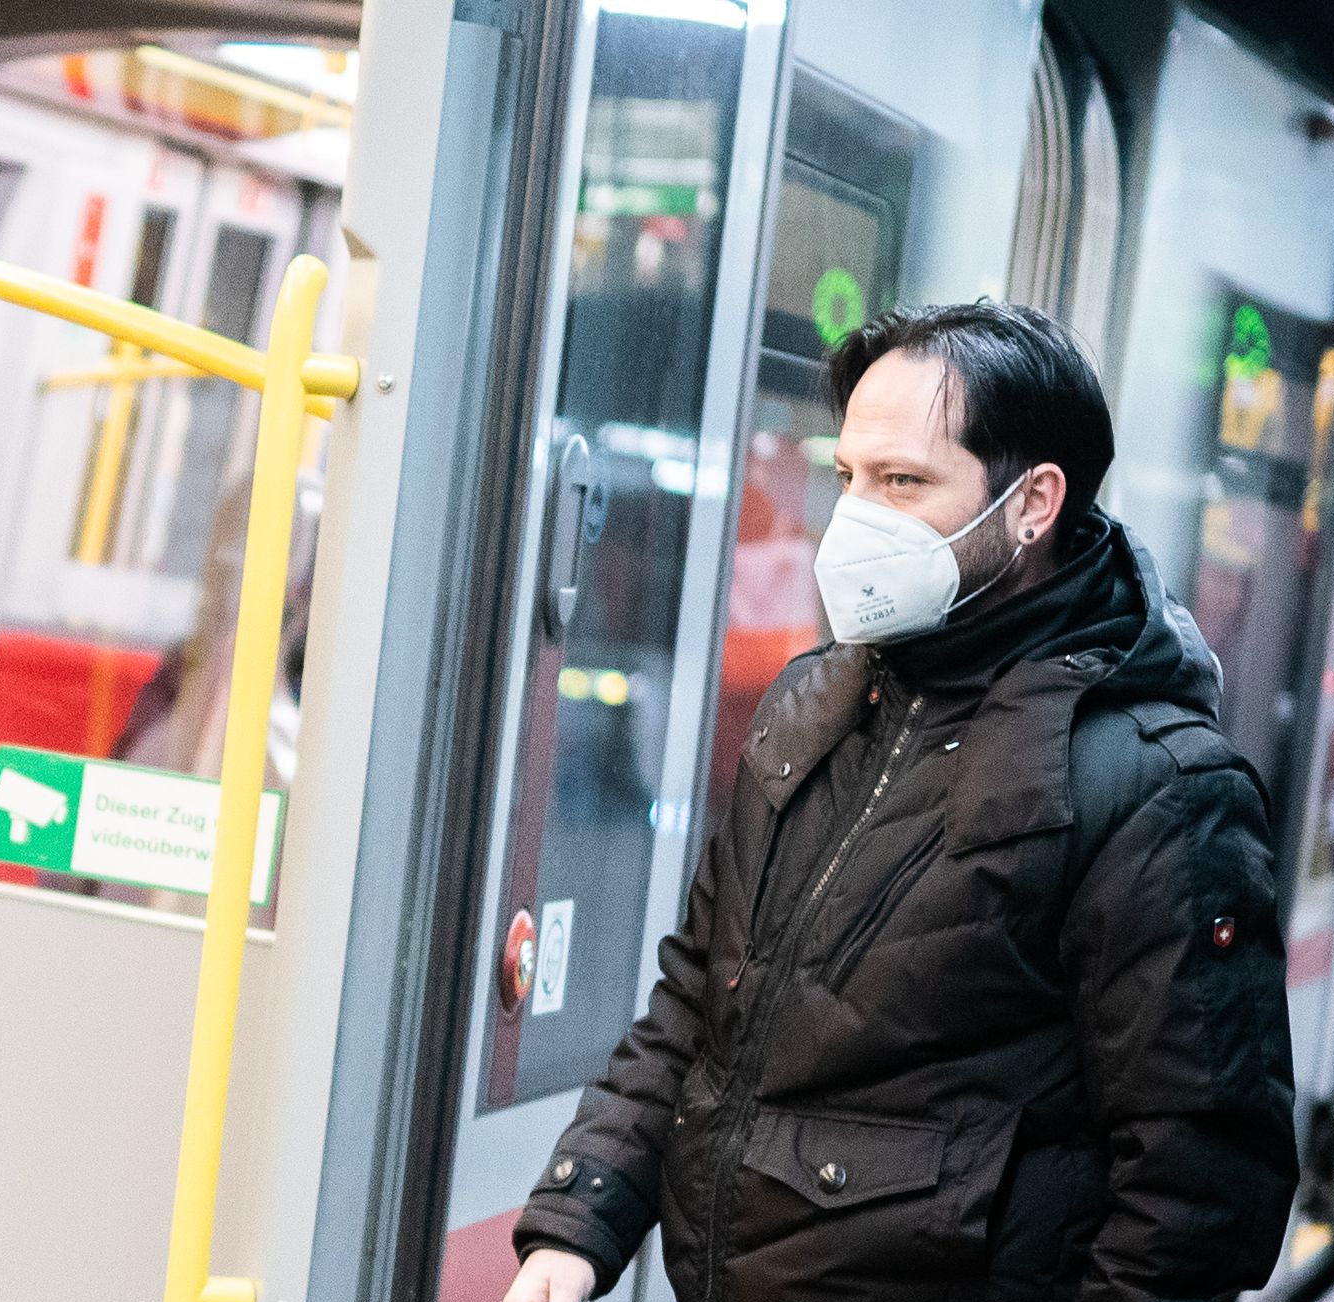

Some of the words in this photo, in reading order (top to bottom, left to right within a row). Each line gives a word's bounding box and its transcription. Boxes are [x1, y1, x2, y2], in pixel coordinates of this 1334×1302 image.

[95, 794, 160, 820] Dieser
[166, 806, 206, 832] Zug
[91, 829, 213, 862] videoüberw
